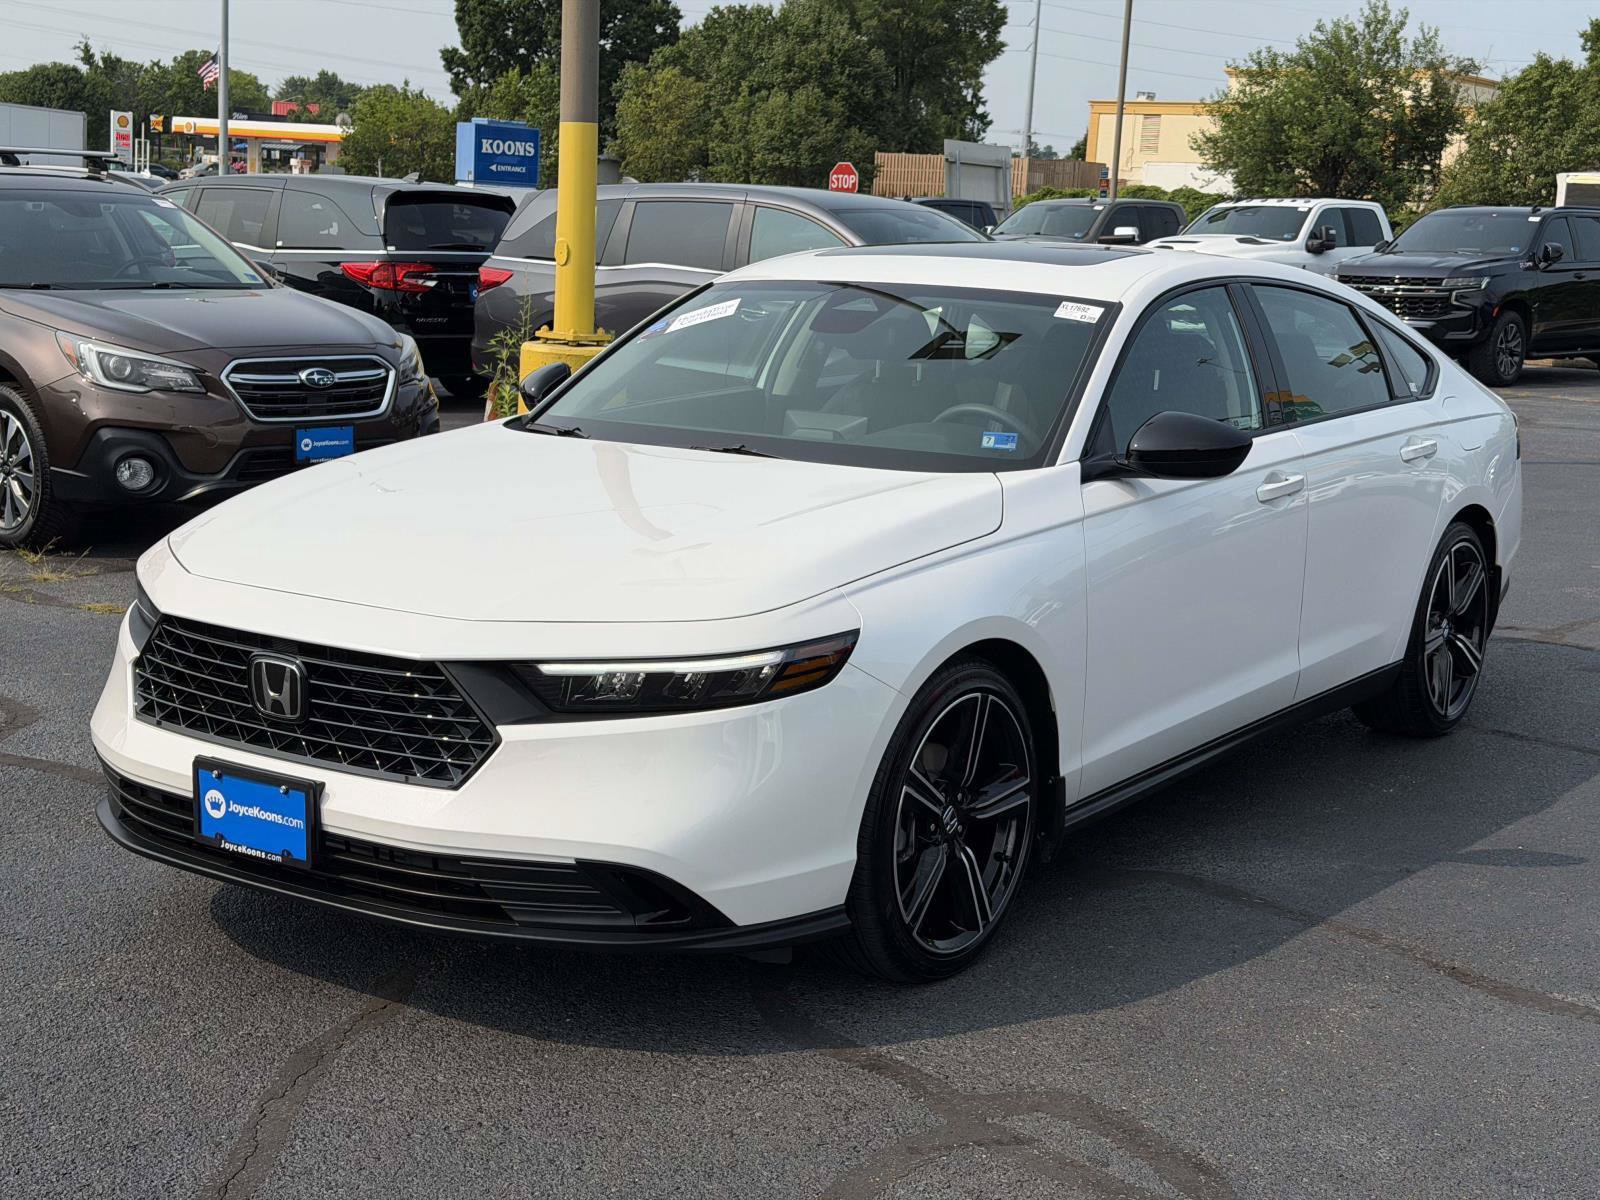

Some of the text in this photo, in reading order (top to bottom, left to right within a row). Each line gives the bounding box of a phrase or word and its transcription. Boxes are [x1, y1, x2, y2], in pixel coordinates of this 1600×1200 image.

[481, 138, 535, 157] KOONS
[497, 164, 527, 173] ENTRANCE
[831, 174, 856, 189] STOP
[985, 436, 992, 444] 7
[228, 800, 304, 829] JoyceKoons.com
[220, 839, 282, 863] JoyceKoons.com
